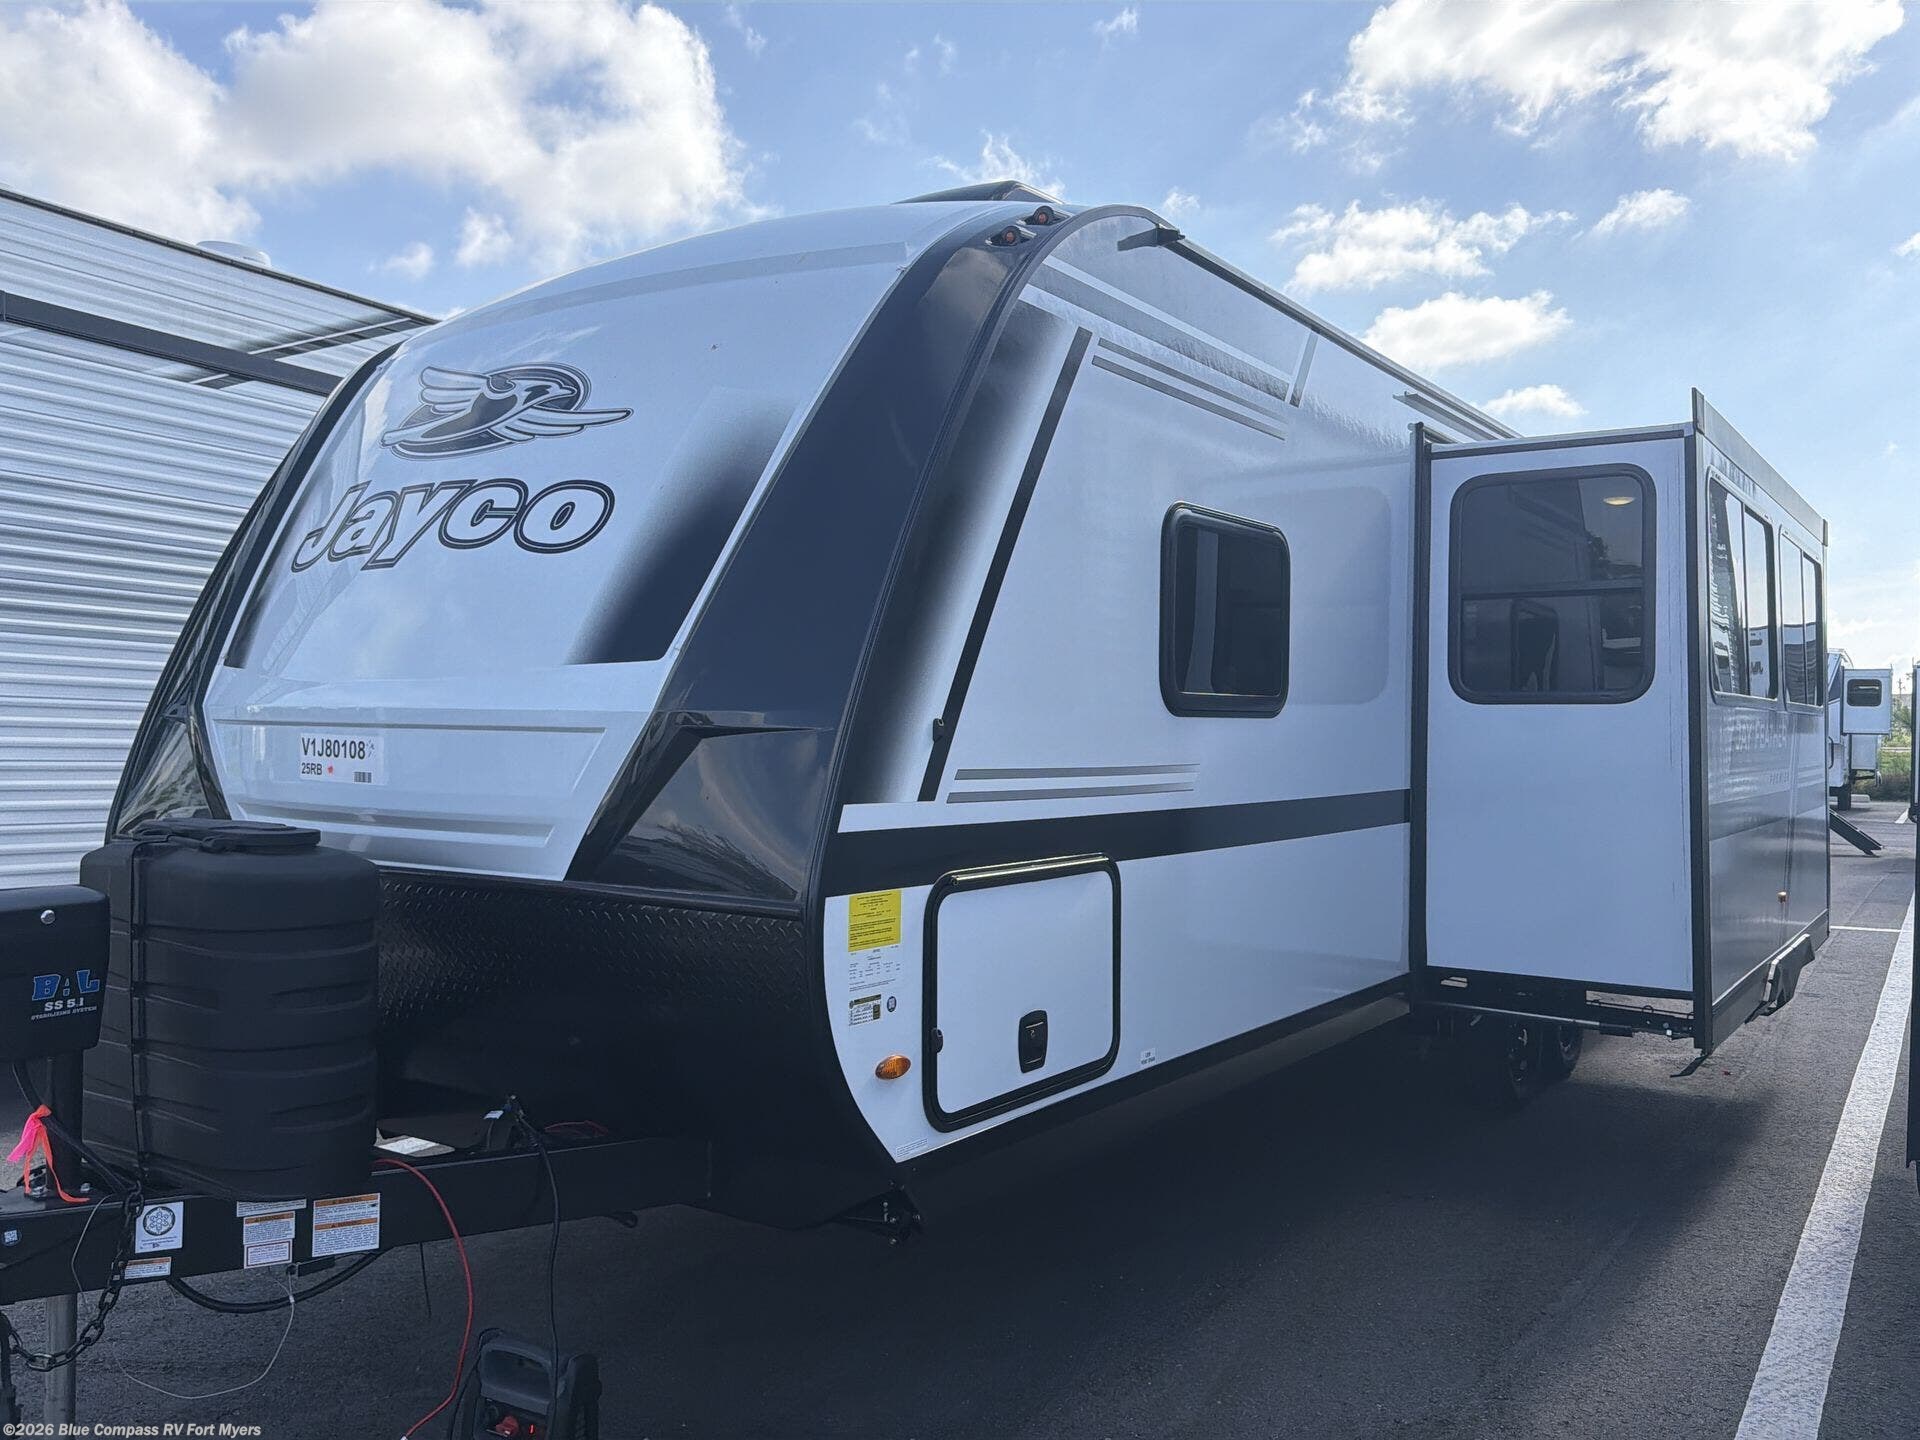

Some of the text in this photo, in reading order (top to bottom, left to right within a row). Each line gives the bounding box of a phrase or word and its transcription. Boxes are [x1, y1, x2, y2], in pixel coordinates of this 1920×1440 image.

[291, 478, 615, 573] Jayco
[301, 737, 366, 760] V1J80108
[301, 762, 323, 776] 25RB
